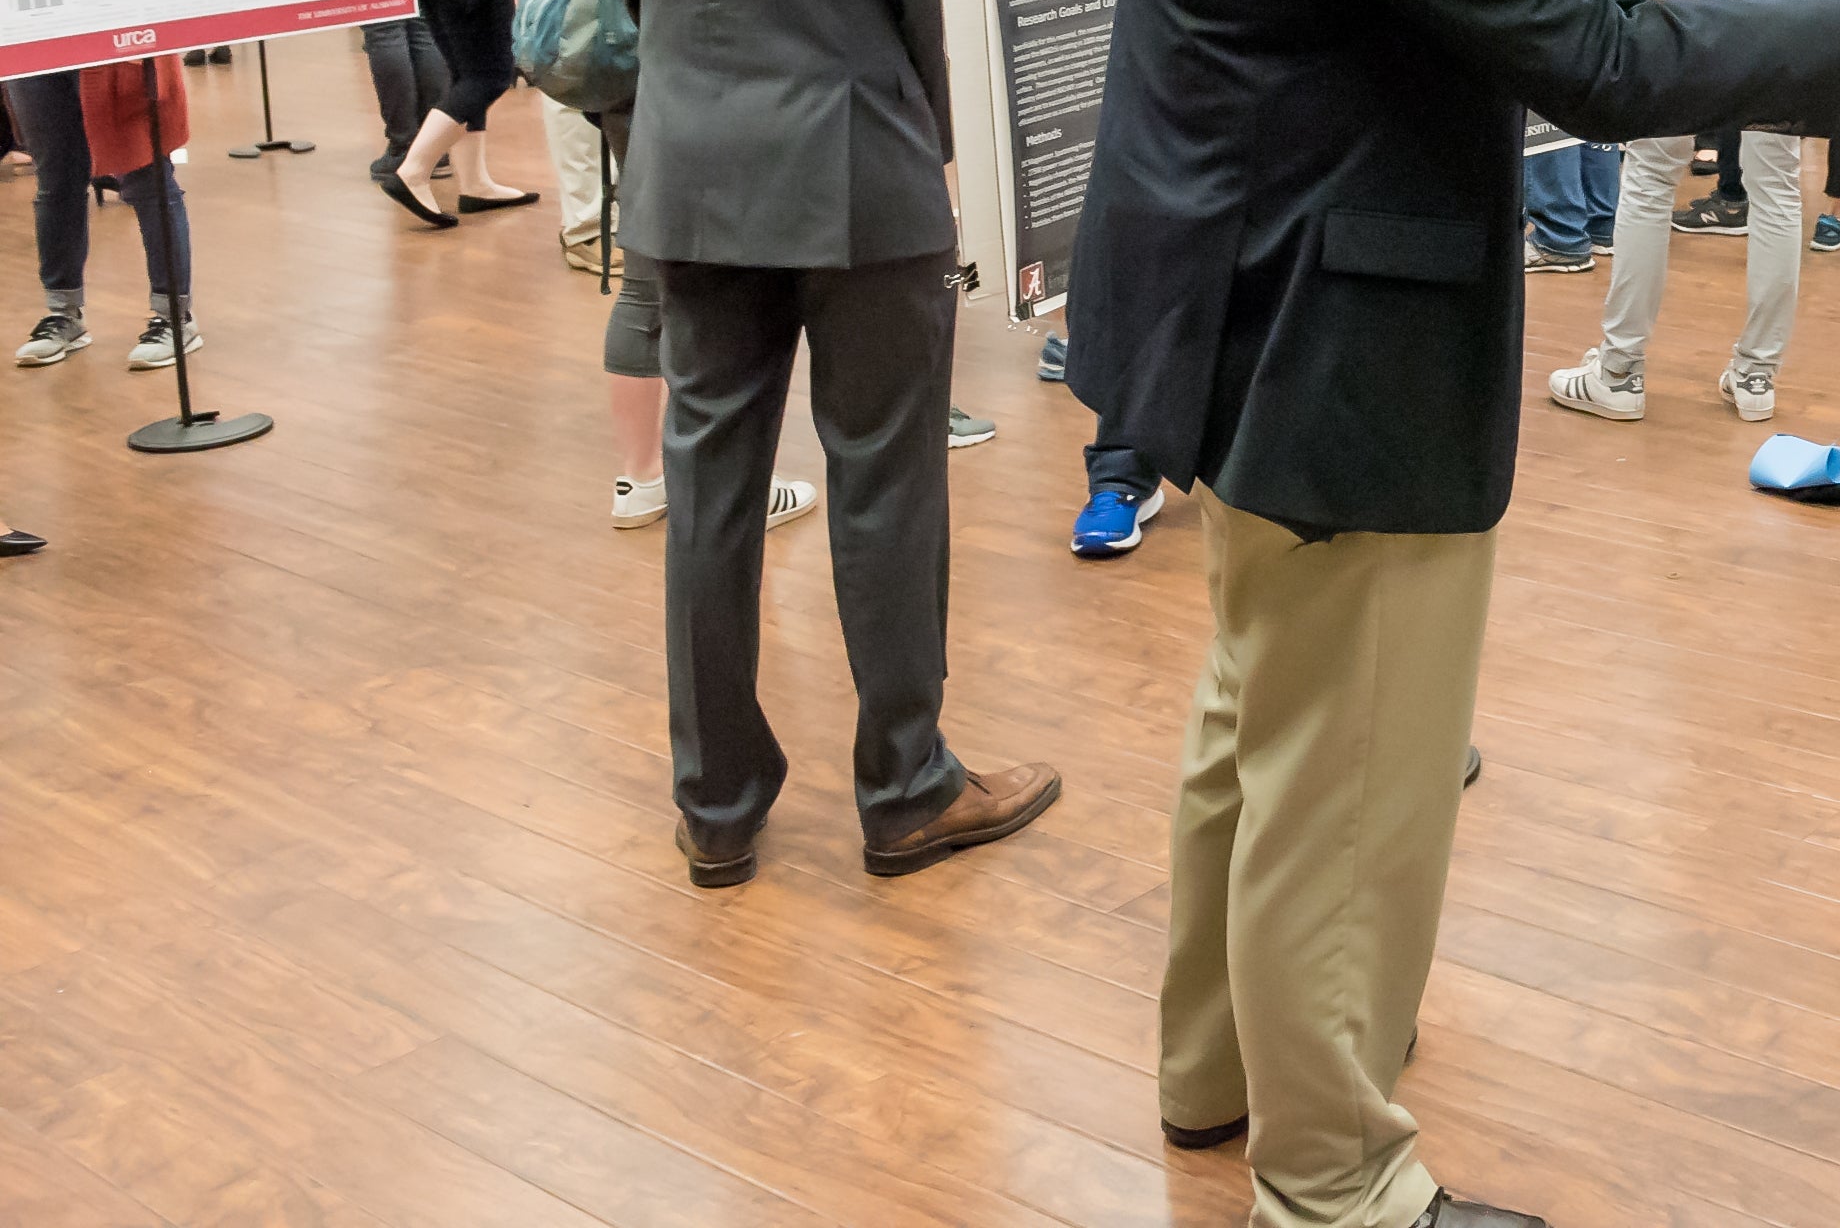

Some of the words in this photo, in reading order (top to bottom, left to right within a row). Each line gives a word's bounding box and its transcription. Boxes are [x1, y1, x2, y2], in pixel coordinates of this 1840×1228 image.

[1016, 9, 1058, 28] Research
[112, 27, 157, 49] urca
[1025, 127, 1063, 148] Methods
